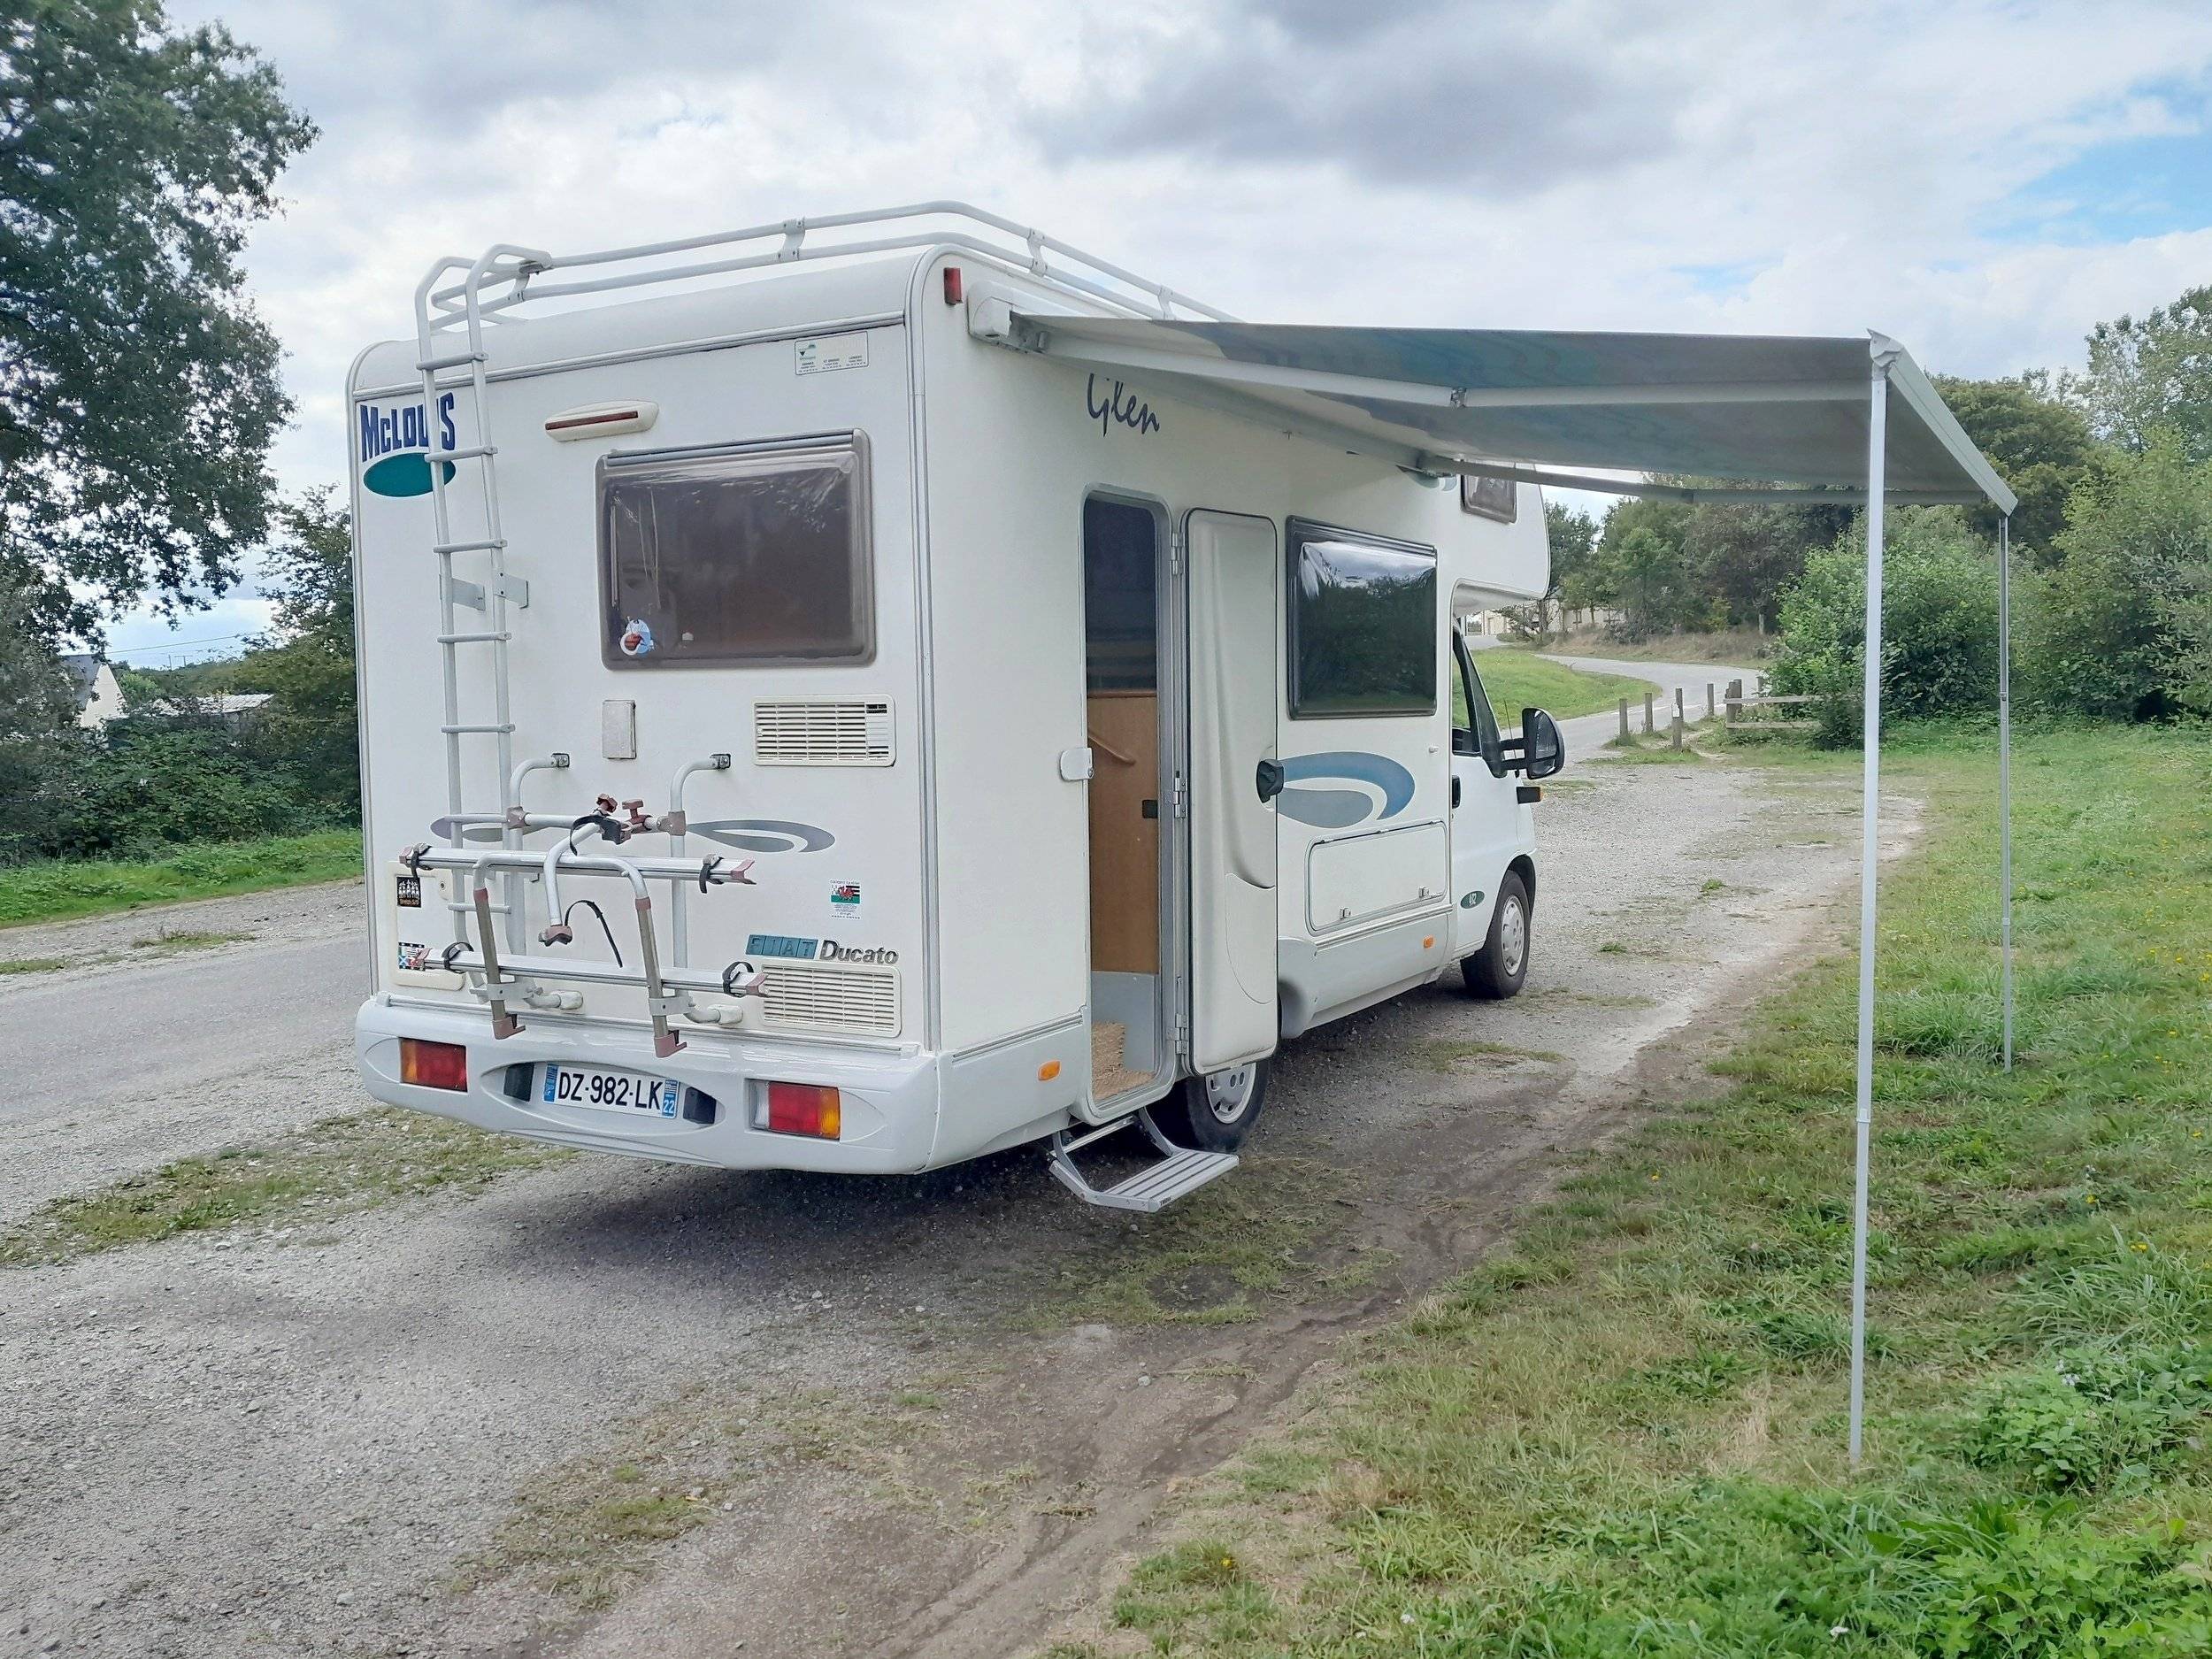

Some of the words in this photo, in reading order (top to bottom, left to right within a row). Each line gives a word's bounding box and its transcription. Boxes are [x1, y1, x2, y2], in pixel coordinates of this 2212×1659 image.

[1087, 373, 1160, 437] Glen
[749, 937, 815, 957] FIAT
[819, 940, 899, 964] Ducato
[664, 1099, 674, 1113] 22
